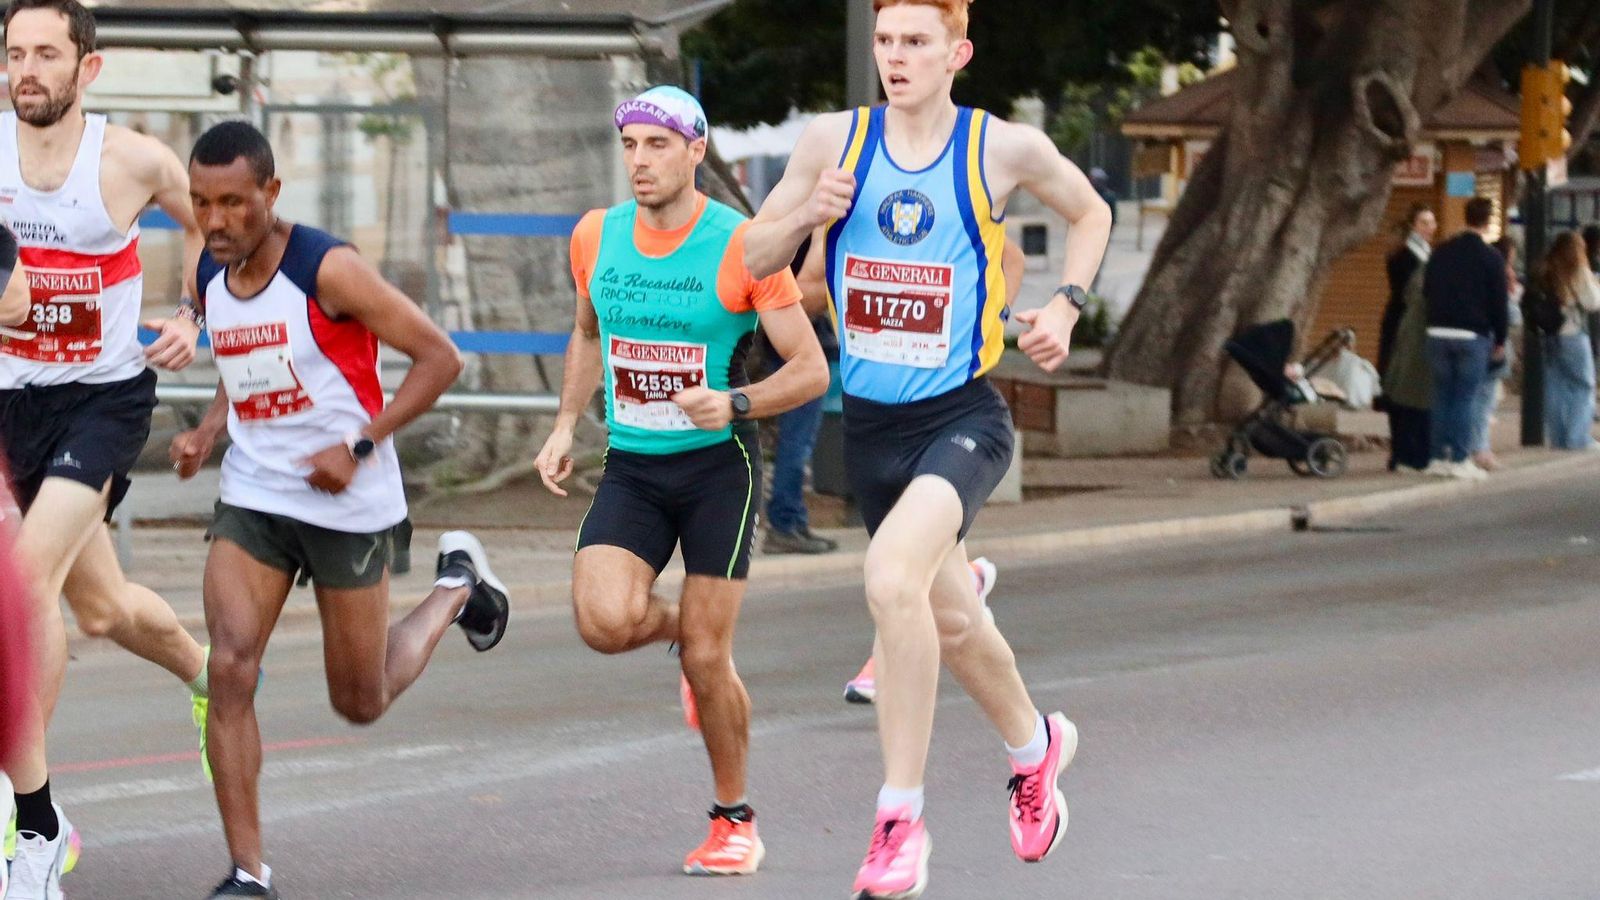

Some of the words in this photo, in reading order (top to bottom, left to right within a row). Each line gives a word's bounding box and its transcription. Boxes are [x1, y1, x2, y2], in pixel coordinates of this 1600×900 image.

[13, 221, 56, 233] BRISTOL
[20, 232, 49, 242] WEST
[53, 234, 67, 244] AC
[870, 264, 944, 285] GENERALI
[32, 303, 73, 324] 338
[862, 294, 926, 320] 11770
[37, 323, 55, 333] PETE
[221, 324, 280, 348] GENERALI
[632, 344, 697, 363] GENERALI
[628, 371, 684, 393] 12535
